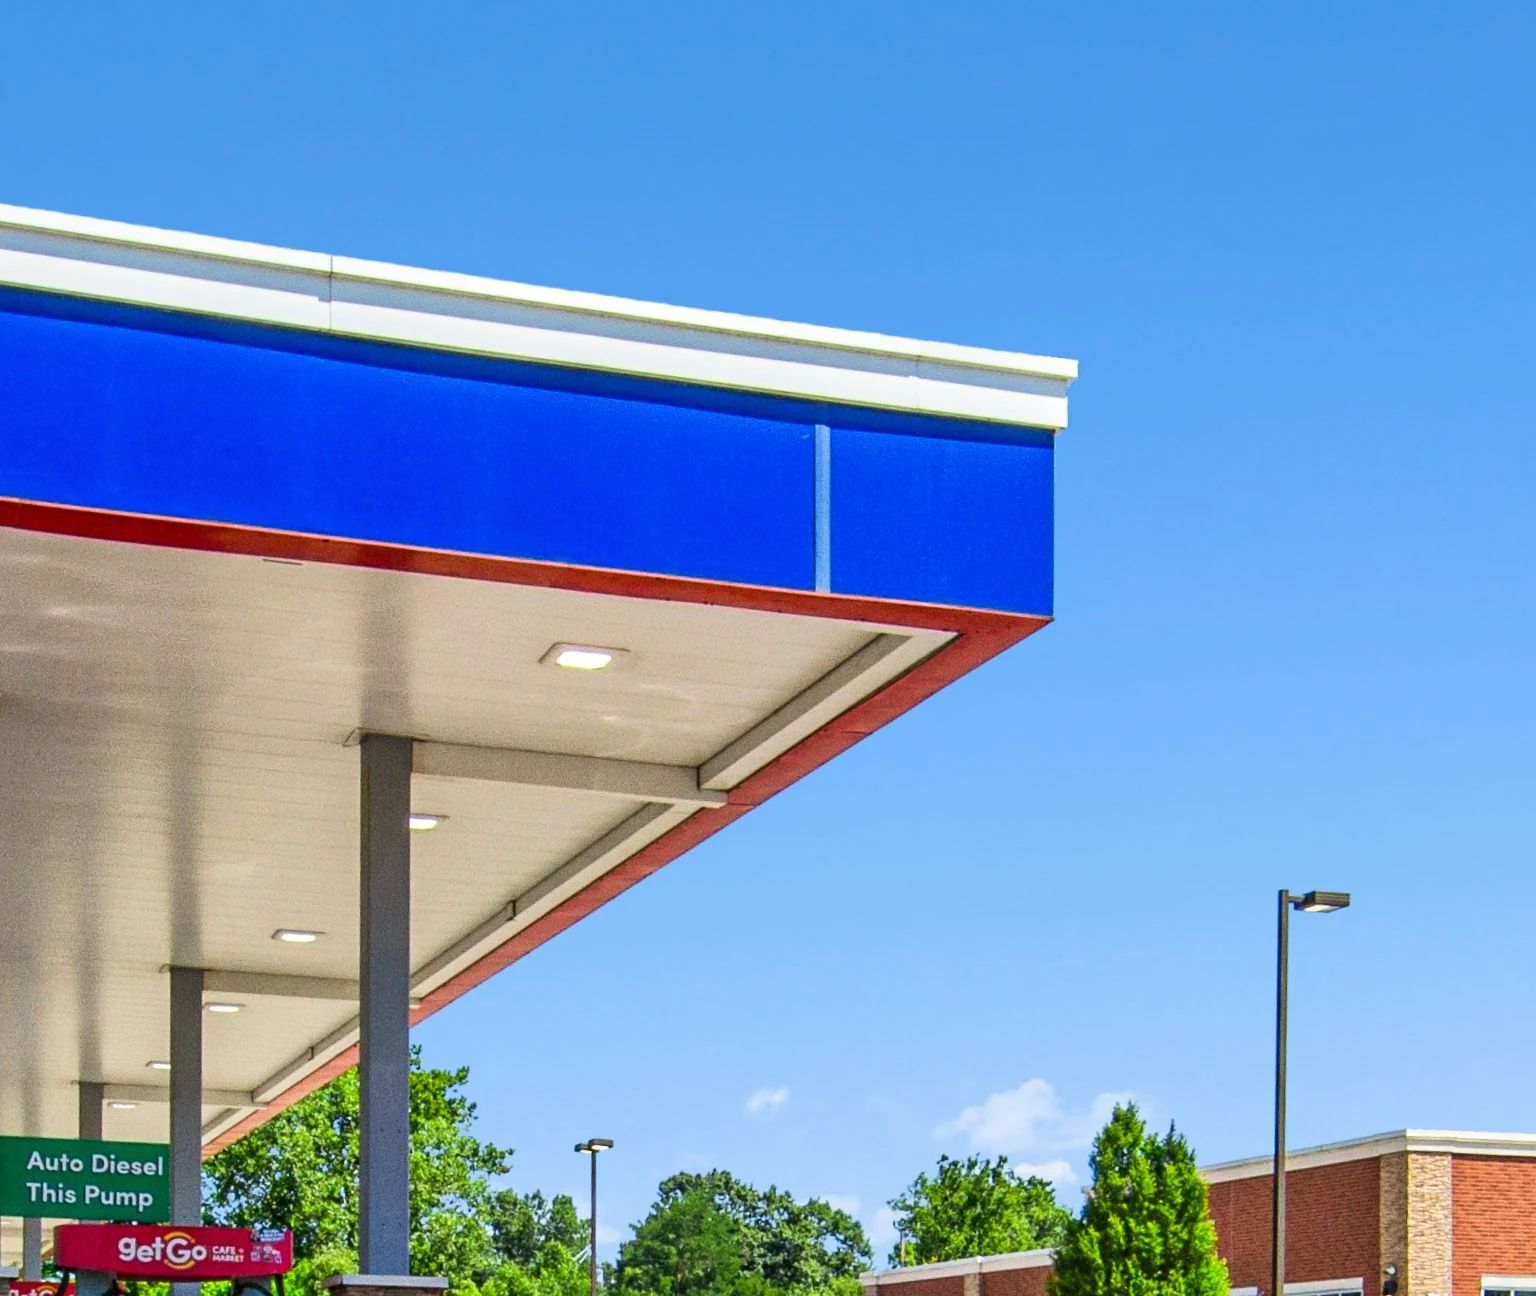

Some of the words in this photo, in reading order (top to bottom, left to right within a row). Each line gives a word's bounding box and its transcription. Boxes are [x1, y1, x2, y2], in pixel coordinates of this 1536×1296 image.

[26, 1151, 84, 1173] Auto
[92, 1154, 164, 1176] Diesel
[26, 1182, 77, 1204] This
[84, 1185, 154, 1212] Pump
[117, 1236, 208, 1264] getGo
